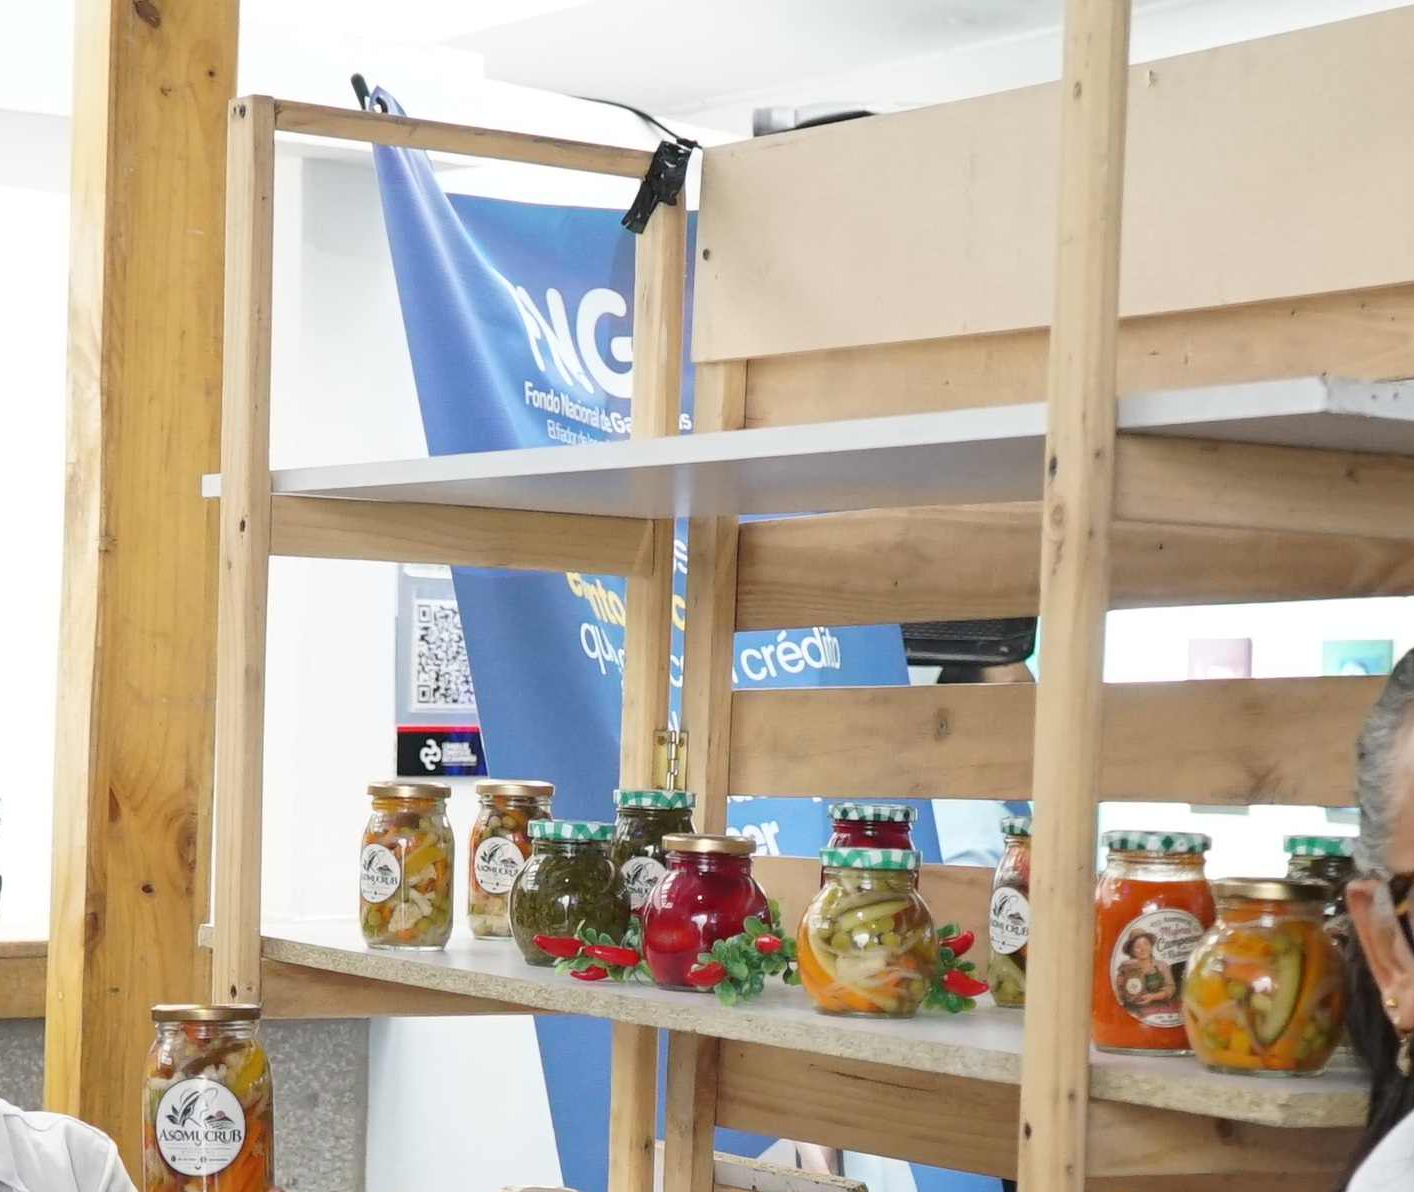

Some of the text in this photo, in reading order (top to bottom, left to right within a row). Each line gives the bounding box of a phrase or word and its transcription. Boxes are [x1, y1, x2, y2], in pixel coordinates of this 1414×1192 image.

[524, 381, 561, 415] Fondo
[561, 392, 600, 429] Nacional
[740, 626, 841, 682] crédito
